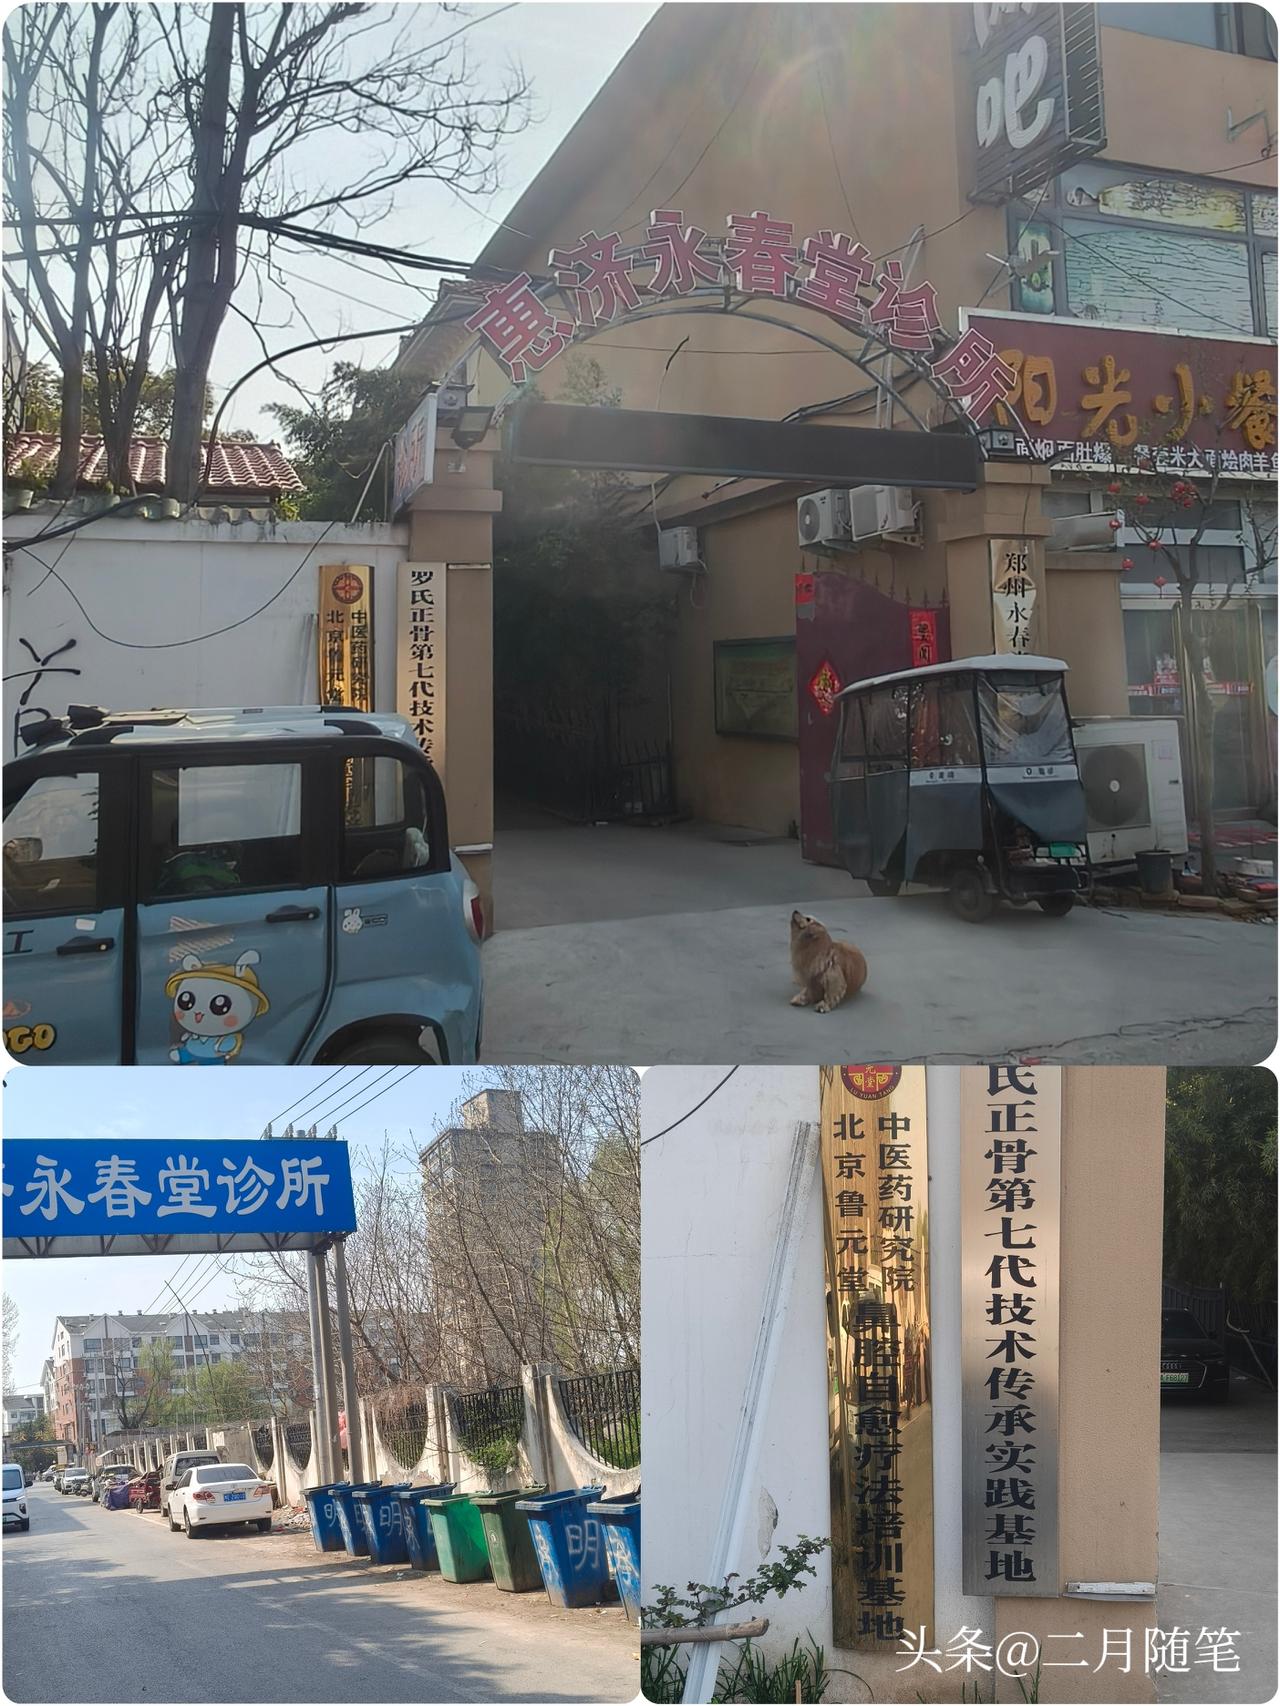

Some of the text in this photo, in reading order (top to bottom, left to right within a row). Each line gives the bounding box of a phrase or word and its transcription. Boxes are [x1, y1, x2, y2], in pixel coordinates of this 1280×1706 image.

[973, 3, 1056, 149] 吧
[464, 209, 1017, 425] 惠济永春堂诊所
[408, 570, 435, 772] 罗氏正骨第七代技术传
[1004, 552, 1031, 655] 郑州永春
[3, 1023, 57, 1054] GO
[3, 1154, 330, 1221] 永春堂诊所
[832, 1113, 868, 1293] 北京鲁元堂
[877, 1111, 915, 1293] 中医药研究院
[983, 1066, 1038, 1584] 氏正骨第七代技术传承实践基地
[565, 1519, 600, 1571] 明
[852, 1301, 906, 1642] 鼻腔自愈疗法培训基地
